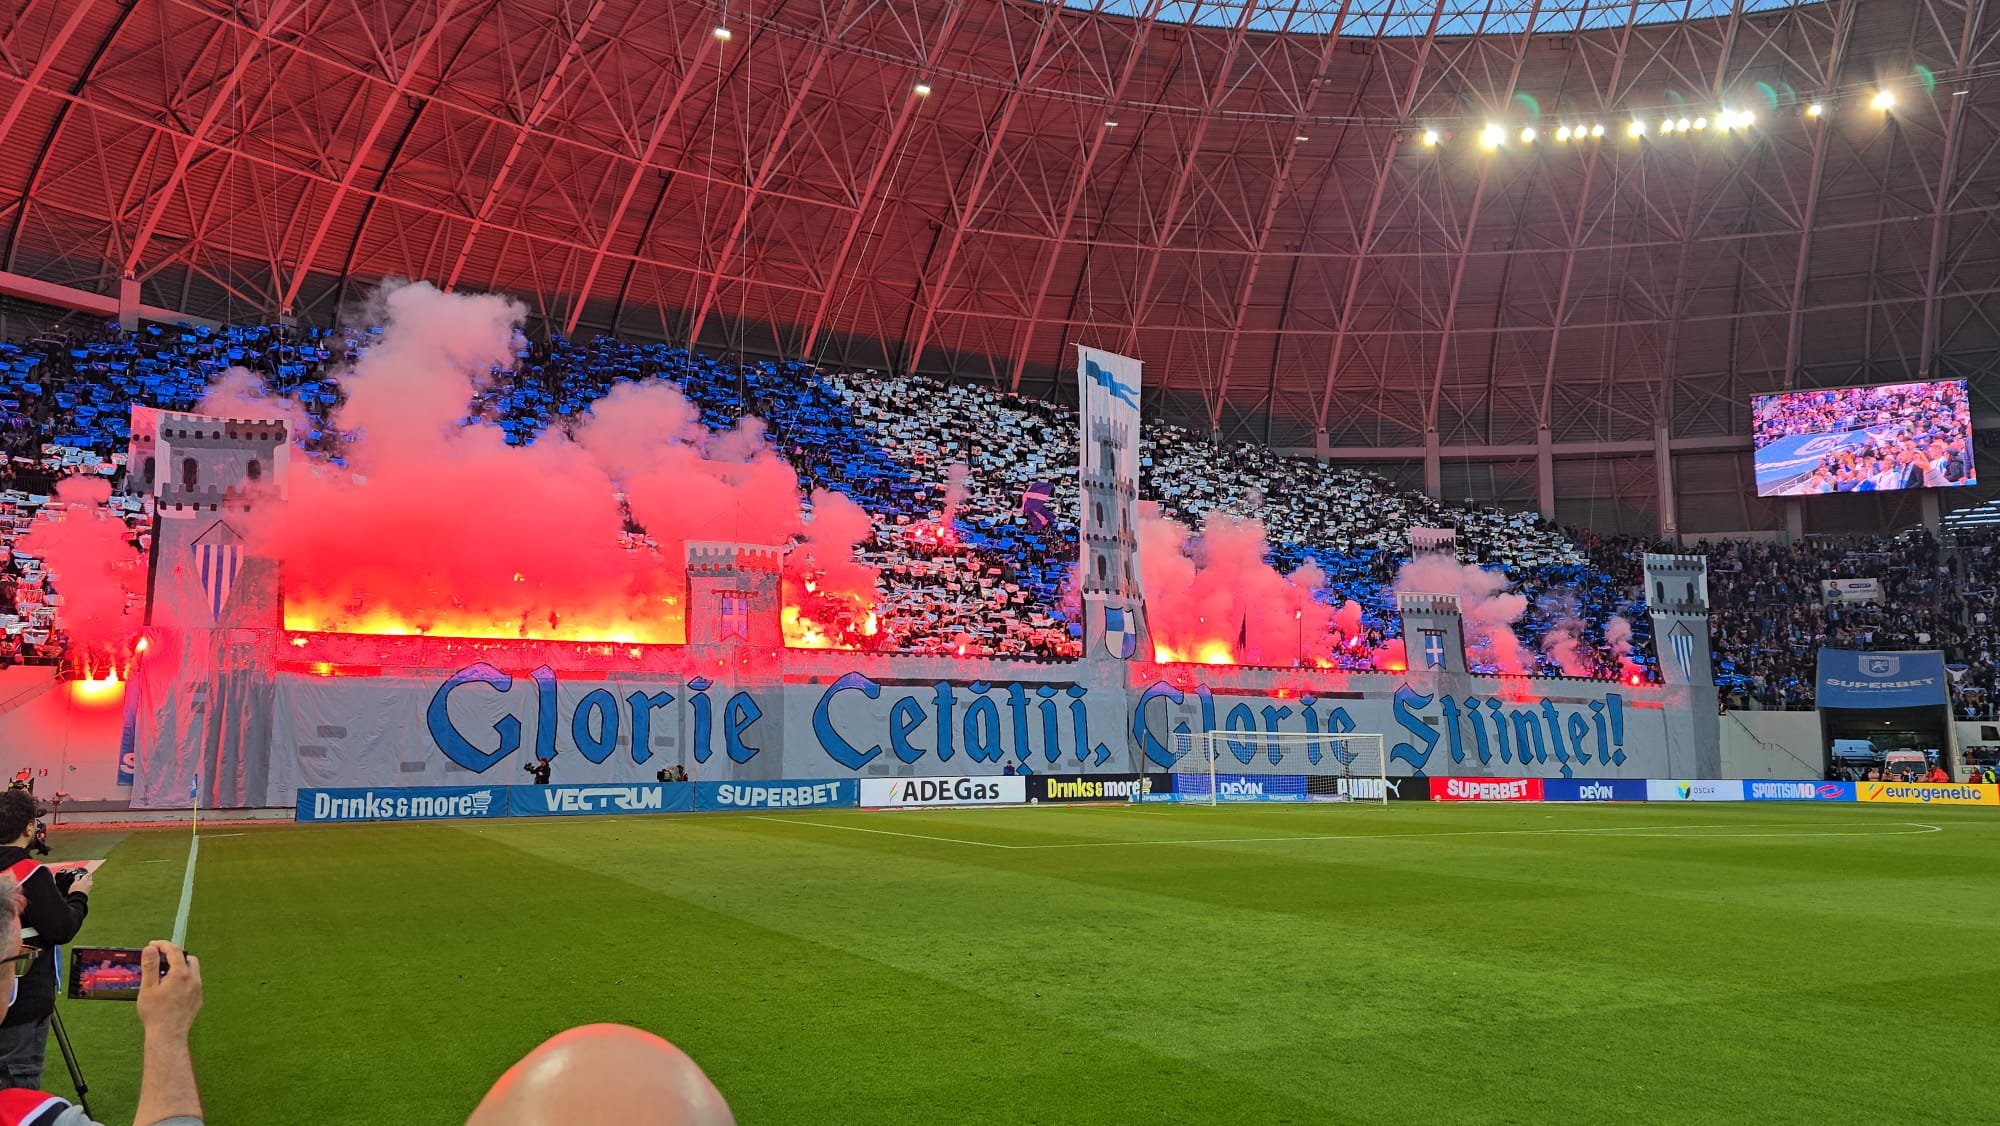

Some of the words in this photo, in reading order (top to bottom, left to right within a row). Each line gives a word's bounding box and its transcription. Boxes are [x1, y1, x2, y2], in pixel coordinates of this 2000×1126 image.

[1825, 678, 1935, 690] SUPERBET
[426, 661, 763, 774] Glorie
[812, 671, 1112, 776] Cetății,
[1132, 680, 1358, 771] Glorie
[717, 781, 840, 807] SUPERBET
[902, 777, 1000, 802] ADEGas
[1220, 781, 1263, 795] DEVIN
[1337, 778, 1383, 799] PUMA
[1447, 779, 1528, 799] SUPERBET
[1579, 784, 1613, 800] DEVIN
[1693, 786, 1715, 794] OSCAR
[1752, 782, 1816, 799] SPORTISIMO
[1886, 785, 1982, 802] eurogenetic
[545, 787, 662, 811] VECTRUM
